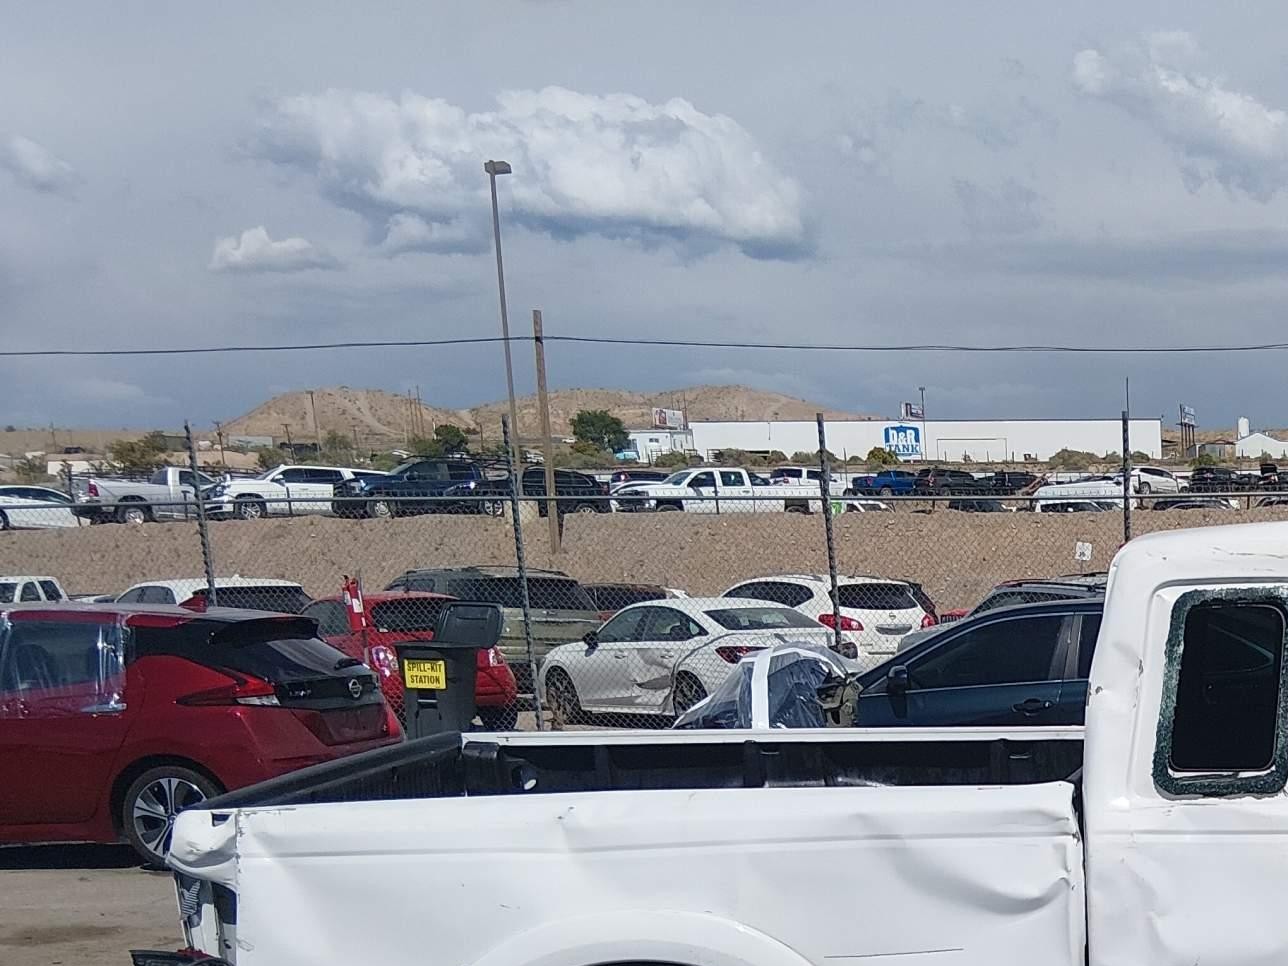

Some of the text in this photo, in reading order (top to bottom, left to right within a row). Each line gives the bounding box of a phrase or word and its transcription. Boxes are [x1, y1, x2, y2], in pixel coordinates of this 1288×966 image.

[889, 428, 915, 444] D&R
[887, 444, 919, 453] TANK
[407, 661, 443, 673] SPILL-KIT
[410, 674, 441, 685] STATION
